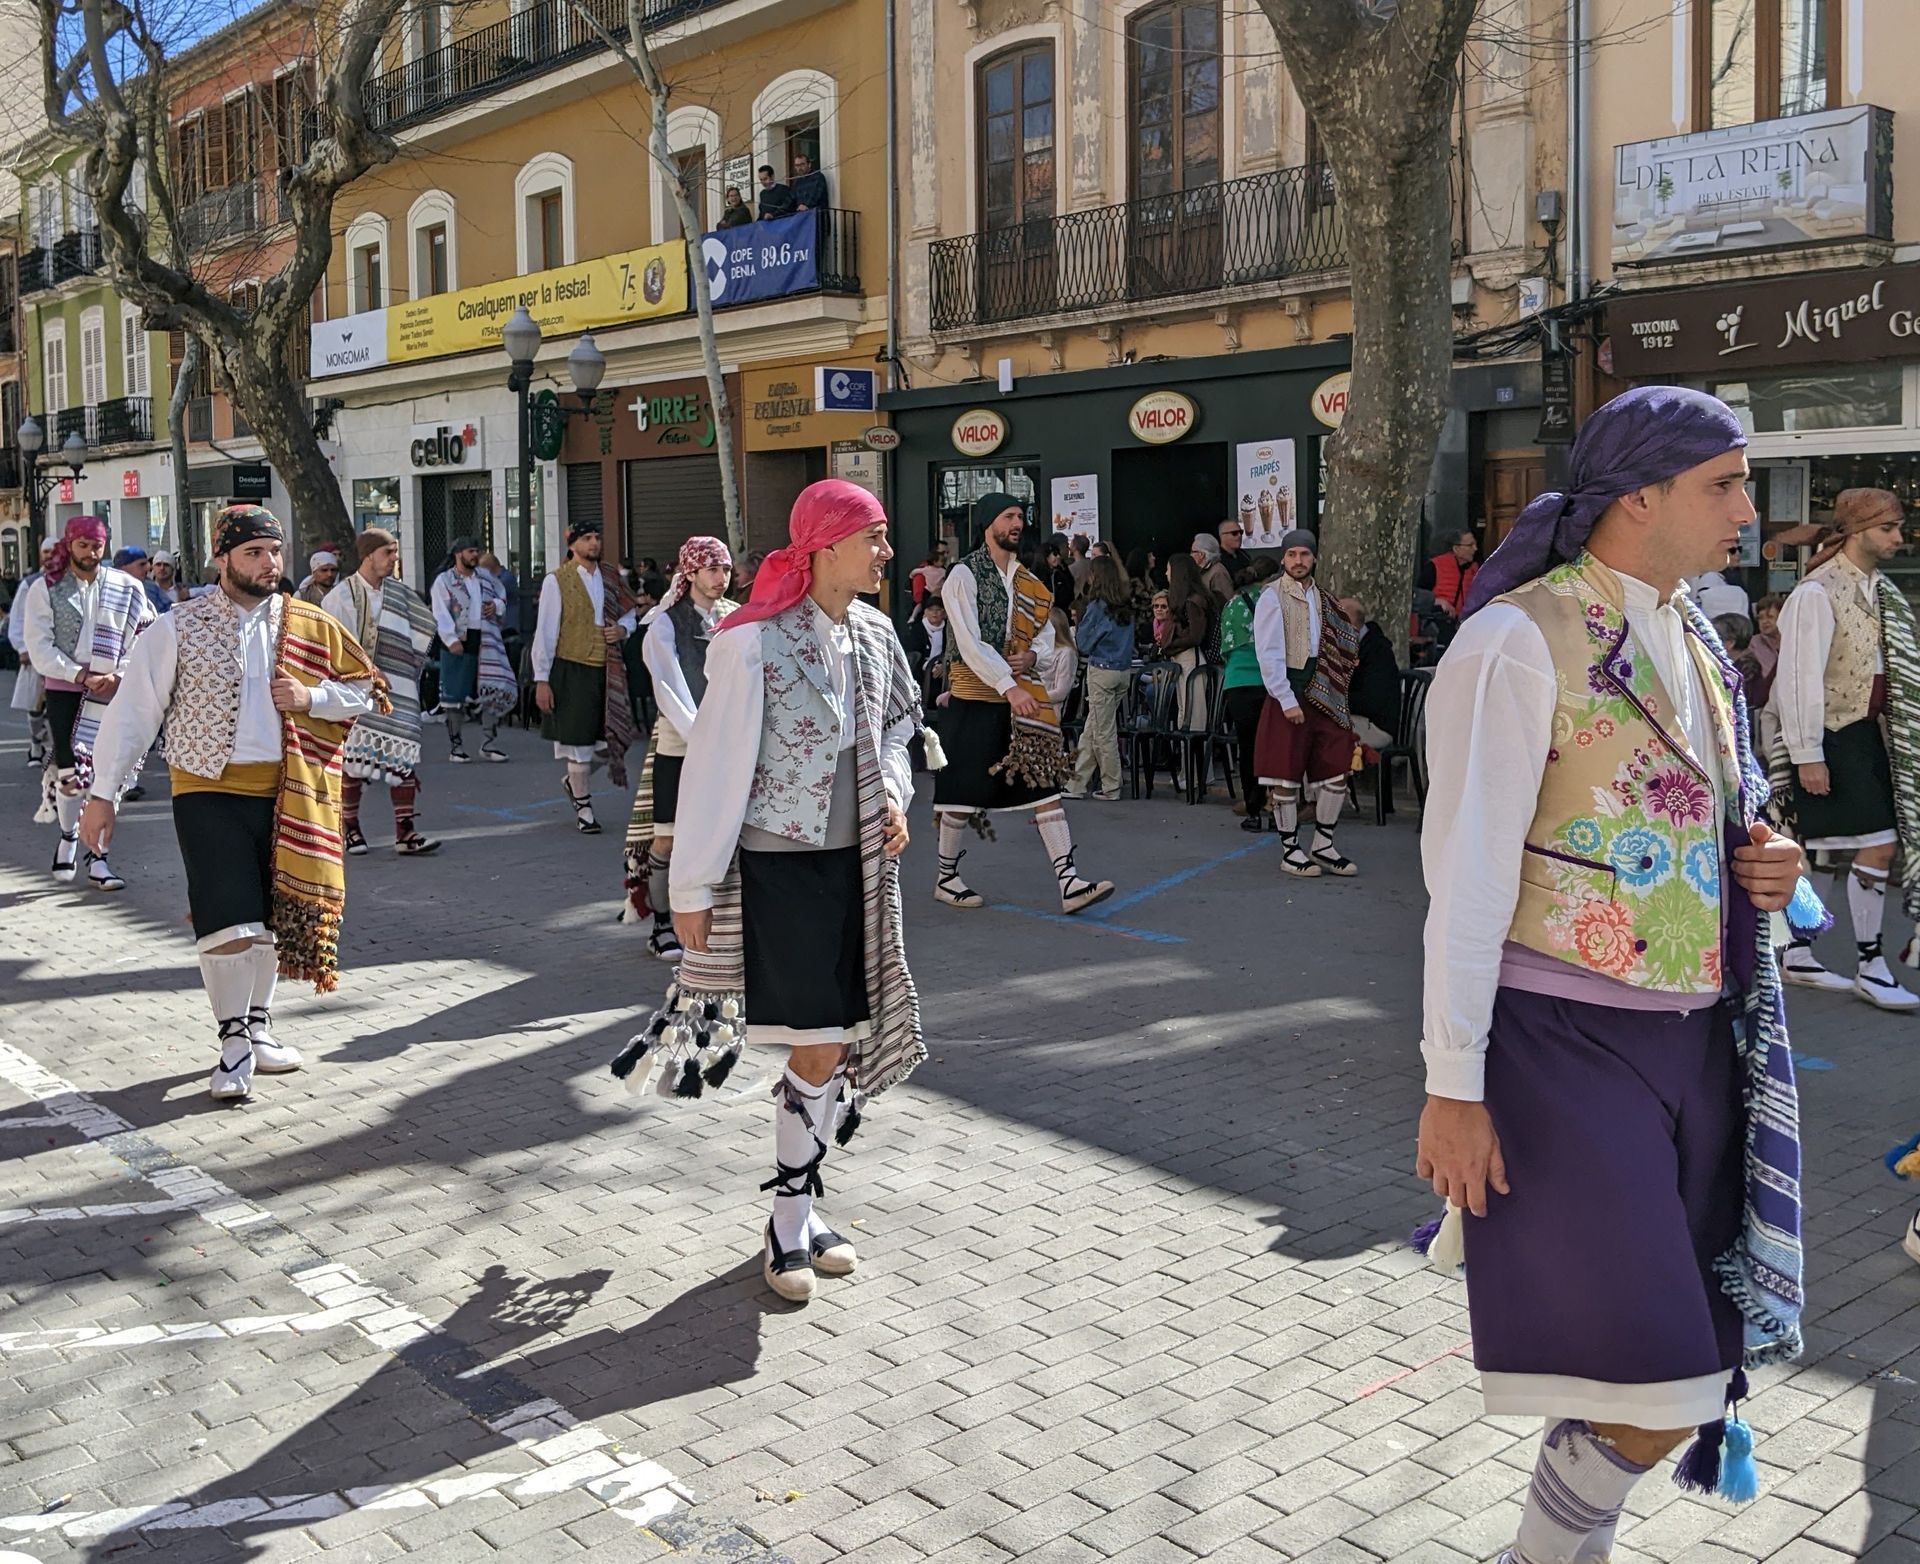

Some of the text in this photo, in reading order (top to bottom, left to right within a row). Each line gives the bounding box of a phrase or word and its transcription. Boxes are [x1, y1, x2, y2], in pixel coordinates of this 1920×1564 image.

[1688, 155, 1725, 182] LA
[1741, 136, 1839, 175] REINA
[1698, 184, 1771, 204] REAL ESTATE
[730, 247, 753, 263] COPE
[760, 243, 809, 269] 89.6 FM
[730, 263, 756, 280] DENIA
[458, 294, 516, 321] Cavalquem
[541, 283, 552, 304] la
[555, 273, 591, 300] festa!
[1777, 280, 1885, 349] Miquel
[1631, 319, 1680, 336] XIXONA
[1641, 335, 1673, 349] 1912
[326, 347, 370, 368] MONGOMAR
[849, 382, 867, 391] COPE
[1136, 407, 1187, 429] VALOR
[868, 434, 896, 444] VALOR
[957, 424, 998, 443] VALOR
[411, 426, 466, 467] celio
[1250, 460, 1281, 479] FRAPPÉS
